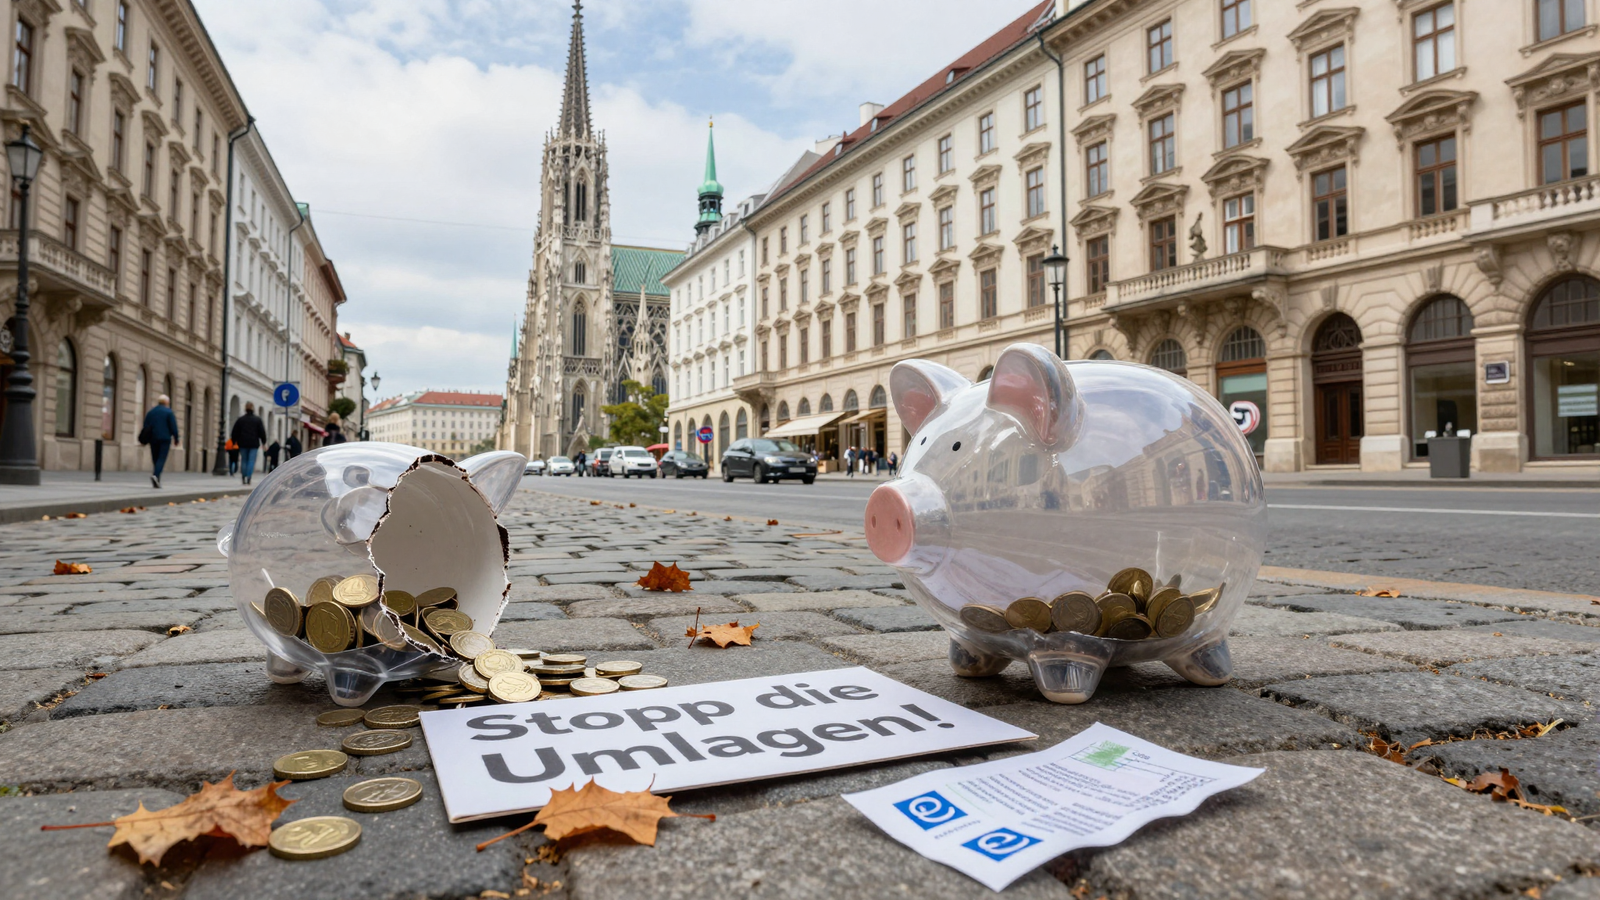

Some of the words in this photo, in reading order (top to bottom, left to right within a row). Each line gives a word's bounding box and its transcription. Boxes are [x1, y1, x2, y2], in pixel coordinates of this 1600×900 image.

[467, 701, 735, 741] Stopp
[757, 682, 879, 709] die
[481, 703, 956, 784] Umlagen!
